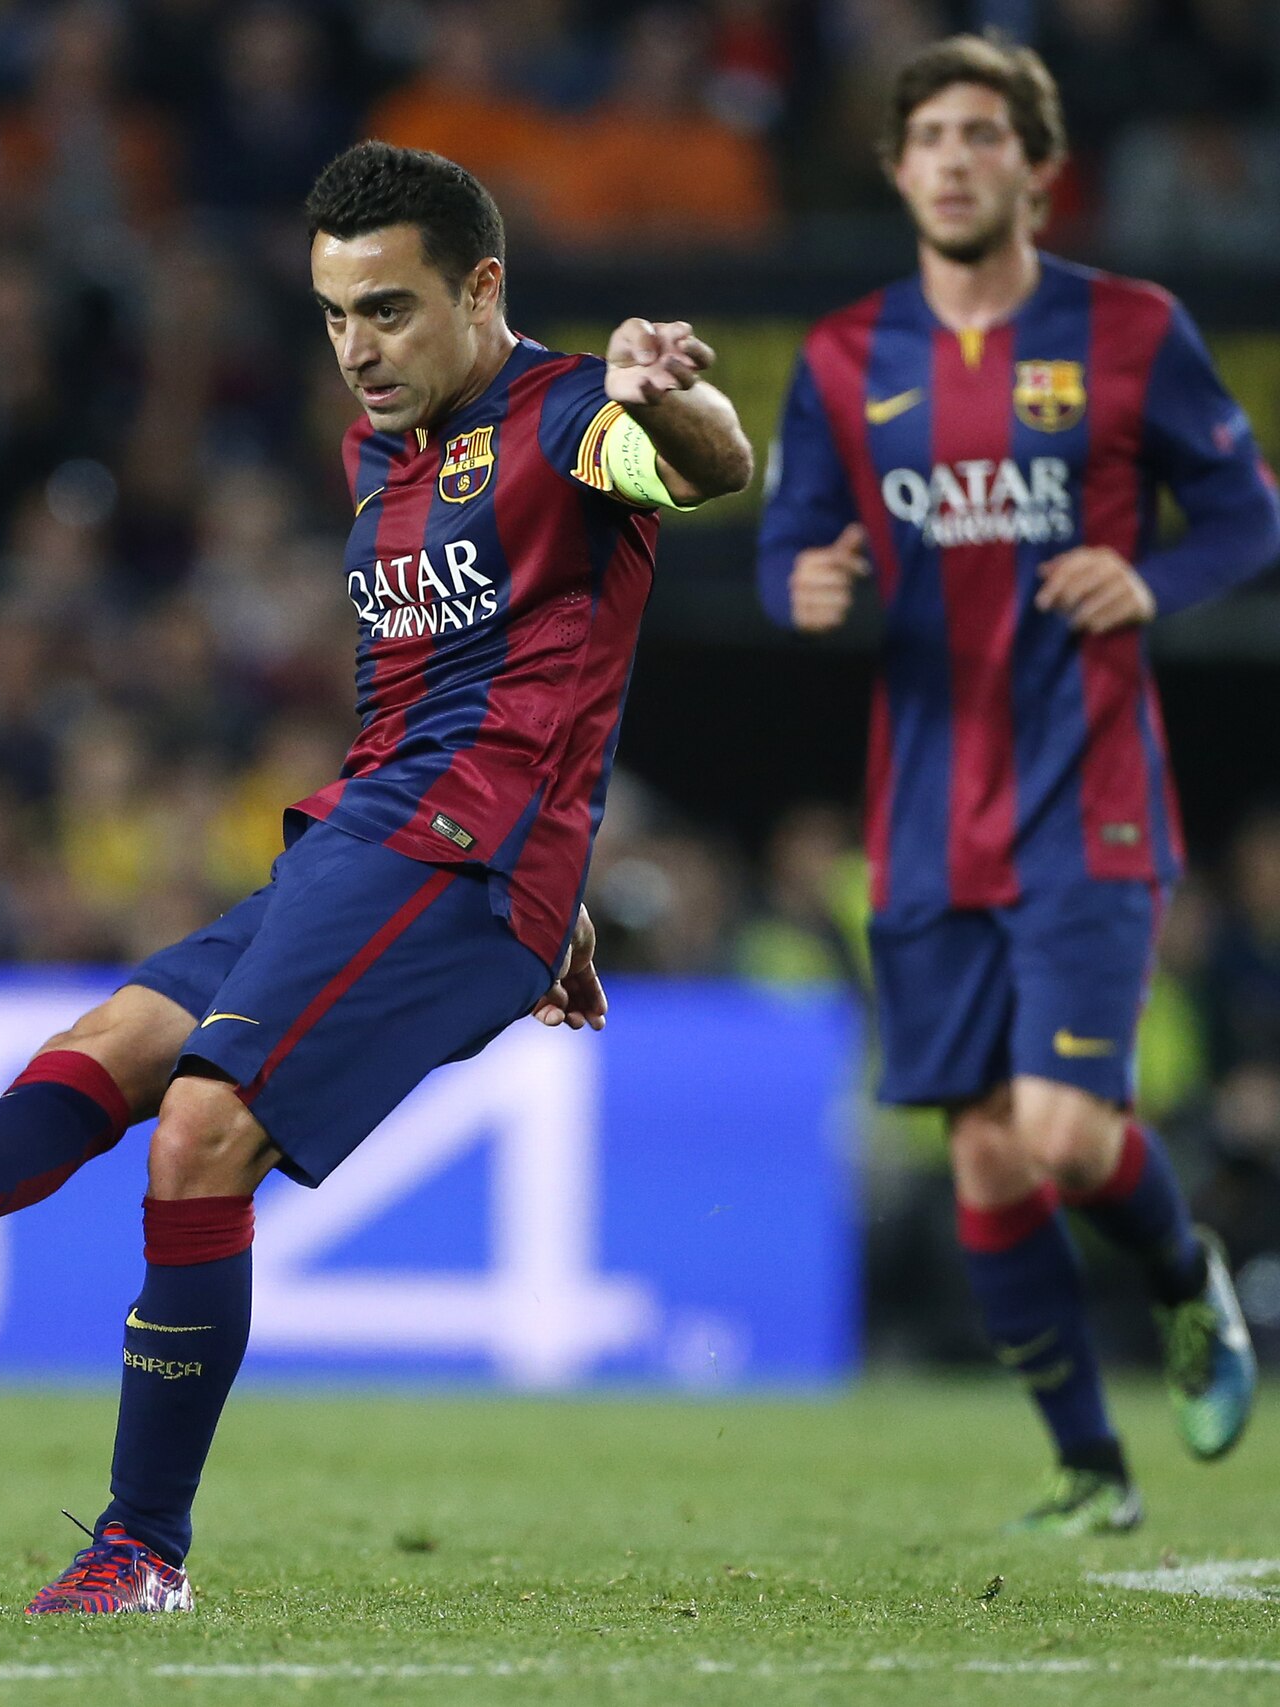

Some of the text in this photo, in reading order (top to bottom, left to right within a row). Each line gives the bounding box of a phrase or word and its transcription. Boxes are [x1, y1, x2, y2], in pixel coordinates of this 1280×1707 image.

[622, 421, 637, 452] RAC
[624, 458, 634, 478] TO
[883, 457, 1070, 528] QATAR
[348, 539, 493, 623] QATAR
[371, 590, 498, 638] AIRWAYS
[124, 1348, 202, 1380] BARÇA
